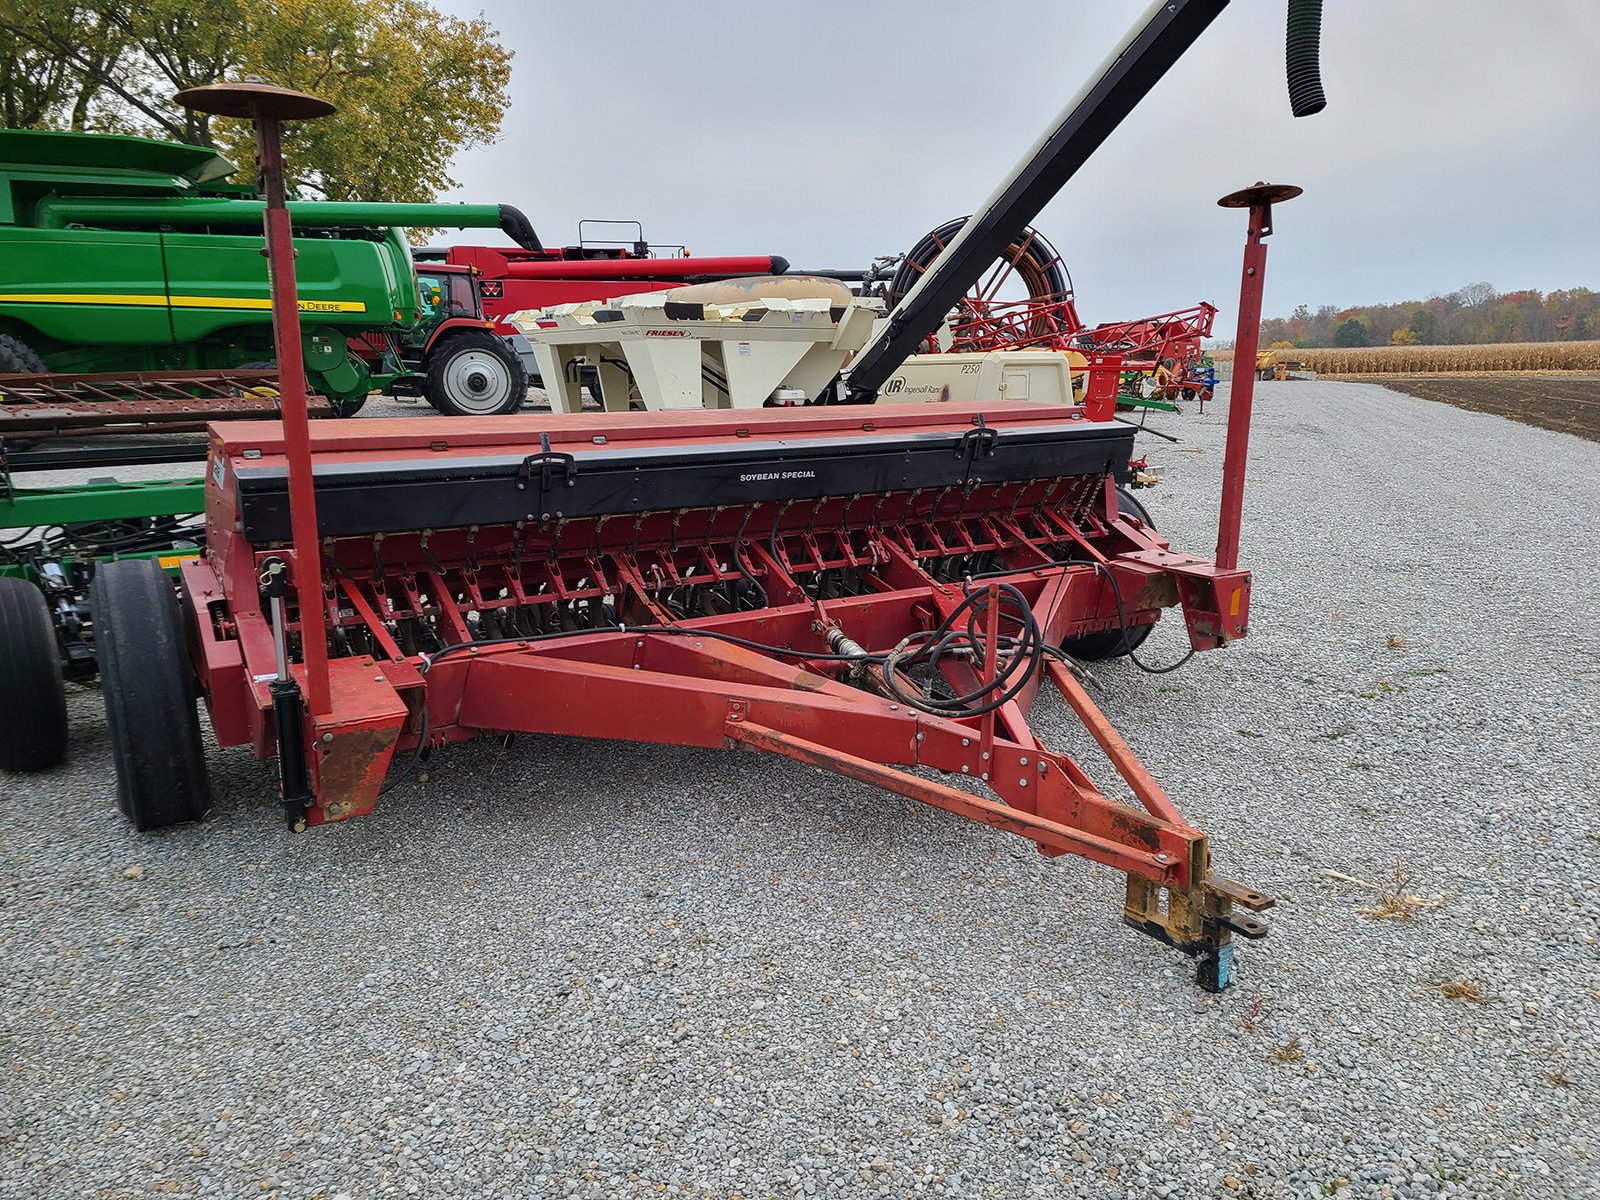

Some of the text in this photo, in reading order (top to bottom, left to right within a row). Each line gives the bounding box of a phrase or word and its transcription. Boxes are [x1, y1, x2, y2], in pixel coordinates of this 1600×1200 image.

[307, 302, 341, 311] DEERE
[645, 329, 687, 337] FRIESEN
[960, 364, 981, 374] P250
[904, 385, 928, 395] Ingersoll
[740, 470, 816, 482] SOYBEAN SPECIAL
